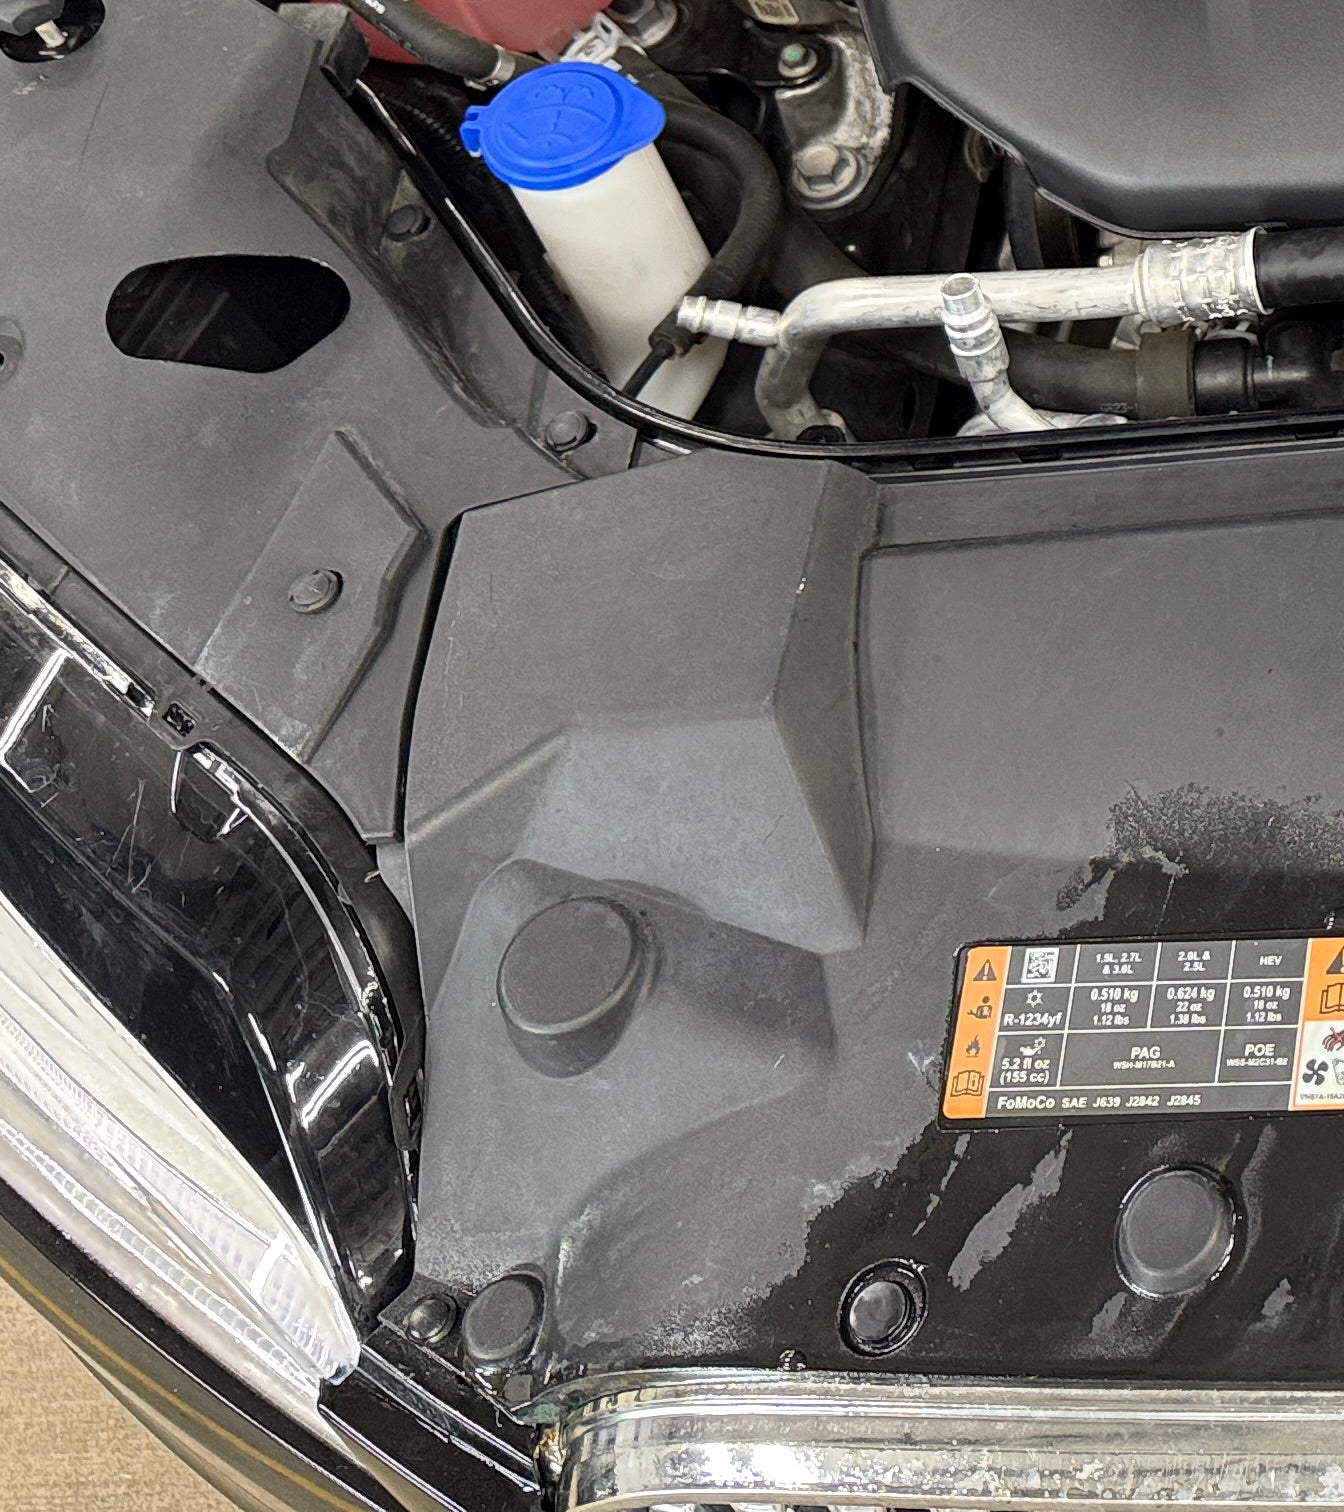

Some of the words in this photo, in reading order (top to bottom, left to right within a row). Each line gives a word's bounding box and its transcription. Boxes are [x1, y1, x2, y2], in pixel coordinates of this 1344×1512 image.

[1120, 952, 1142, 963] 2.7L
[1177, 951, 1200, 961] 2.0L
[1201, 951, 1211, 960] &
[1259, 956, 1283, 966] HEV
[1102, 965, 1110, 974] &
[1112, 965, 1134, 974] 3.0L
[1183, 962, 1205, 971] 2.5L
[1090, 988, 1122, 1001] 0.510
[1123, 987, 1139, 1003] kg
[1166, 987, 1199, 1000] 0.624
[1200, 987, 1216, 1001] kg
[1243, 986, 1275, 998] 0.510
[1275, 986, 1291, 1000] kg
[1100, 1003, 1112, 1013] 18
[1113, 1004, 1127, 1013] oz
[1176, 1002, 1188, 1012] 22
[1189, 1003, 1203, 1011] oz
[1253, 1000, 1265, 1010] 18
[1265, 1001, 1279, 1010] oz
[1003, 1012, 1063, 1028] R-1234yf
[1092, 1015, 1113, 1026] 1.12
[1113, 1014, 1130, 1025] lbs
[1190, 1013, 1207, 1024] lbs
[1246, 1012, 1266, 1023] 1.12
[1266, 1011, 1283, 1022] lbs
[1131, 1046, 1161, 1060] PAG
[1244, 1043, 1276, 1056] POE
[1001, 1058, 1021, 1070] 5.2
[1022, 1057, 1033, 1069] fl
[1034, 1058, 1051, 1069] oz
[1000, 1071, 1028, 1085] (155
[1029, 1070, 1050, 1084] cc)
[997, 1095, 1056, 1110] FoMoCo
[1061, 1097, 1088, 1108] SAE
[1092, 1096, 1122, 1108] J639
[1125, 1095, 1160, 1108] J2842
[1166, 1094, 1202, 1107] J2845
